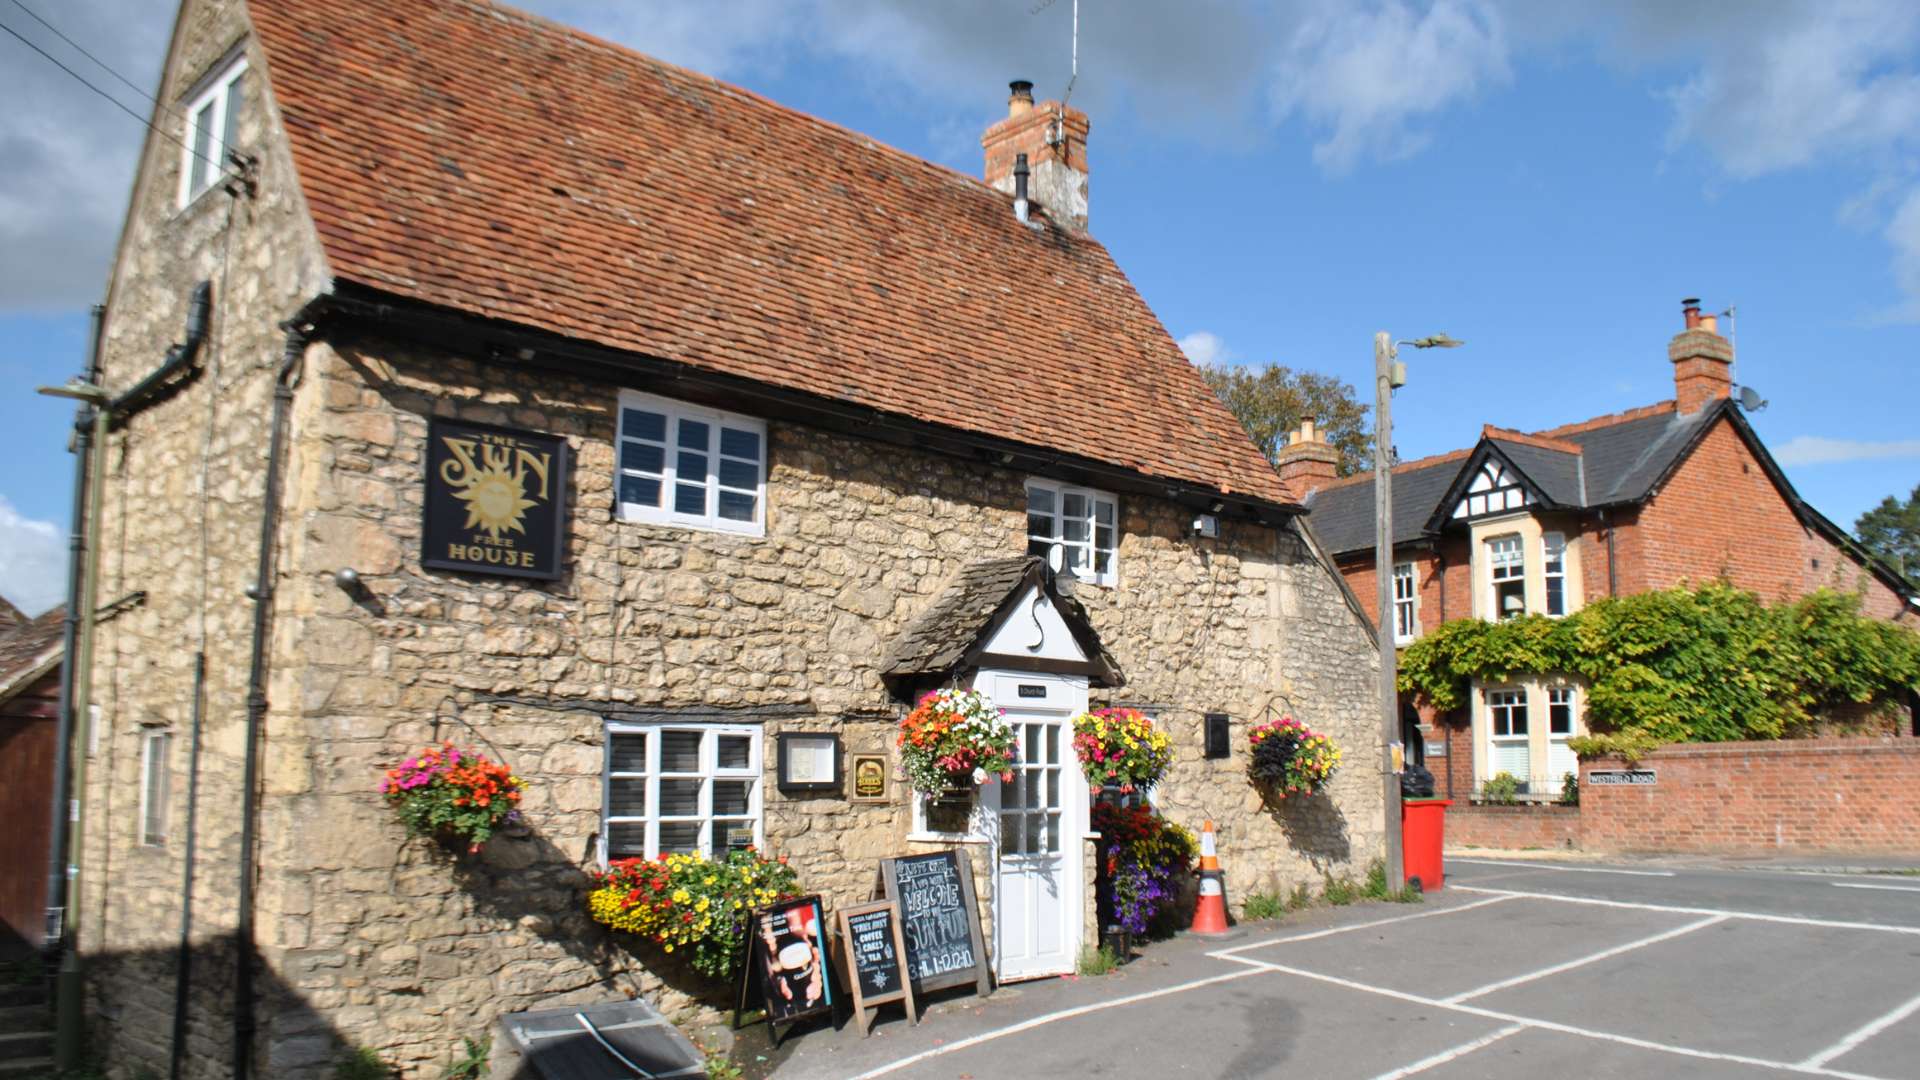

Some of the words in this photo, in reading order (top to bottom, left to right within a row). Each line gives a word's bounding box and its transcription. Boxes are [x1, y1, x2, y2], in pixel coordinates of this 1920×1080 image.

[481, 434, 516, 448] THE
[440, 437, 552, 500] SUN
[473, 534, 514, 548] FREE
[448, 543, 535, 568] HOUSE
[904, 883, 959, 912] WELCOME
[859, 929, 883, 944] COFFEE
[906, 918, 938, 952] SUN
[862, 940, 884, 952] CAKES
[867, 951, 881, 962] TEA
